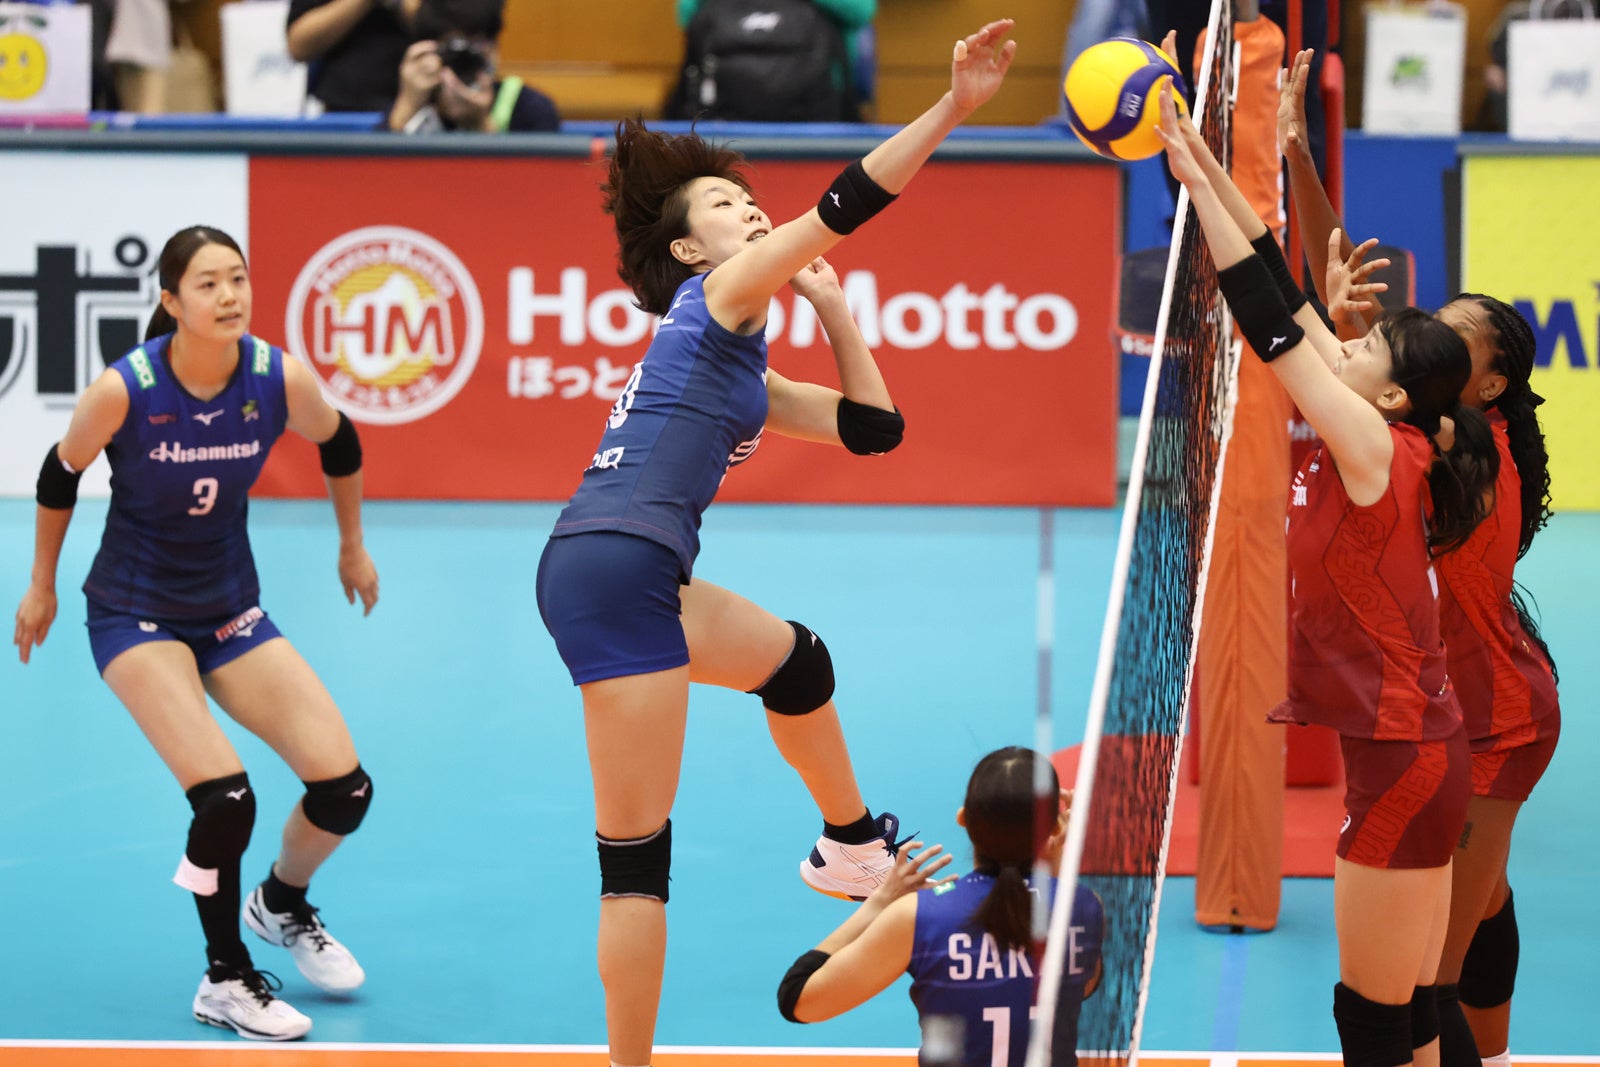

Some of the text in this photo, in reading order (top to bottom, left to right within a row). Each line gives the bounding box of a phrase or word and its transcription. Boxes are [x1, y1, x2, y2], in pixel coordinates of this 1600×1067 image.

[315, 296, 456, 365] HM
[789, 270, 1078, 350] Motto
[187, 477, 218, 516] 3
[948, 926, 1085, 981] SAKE
